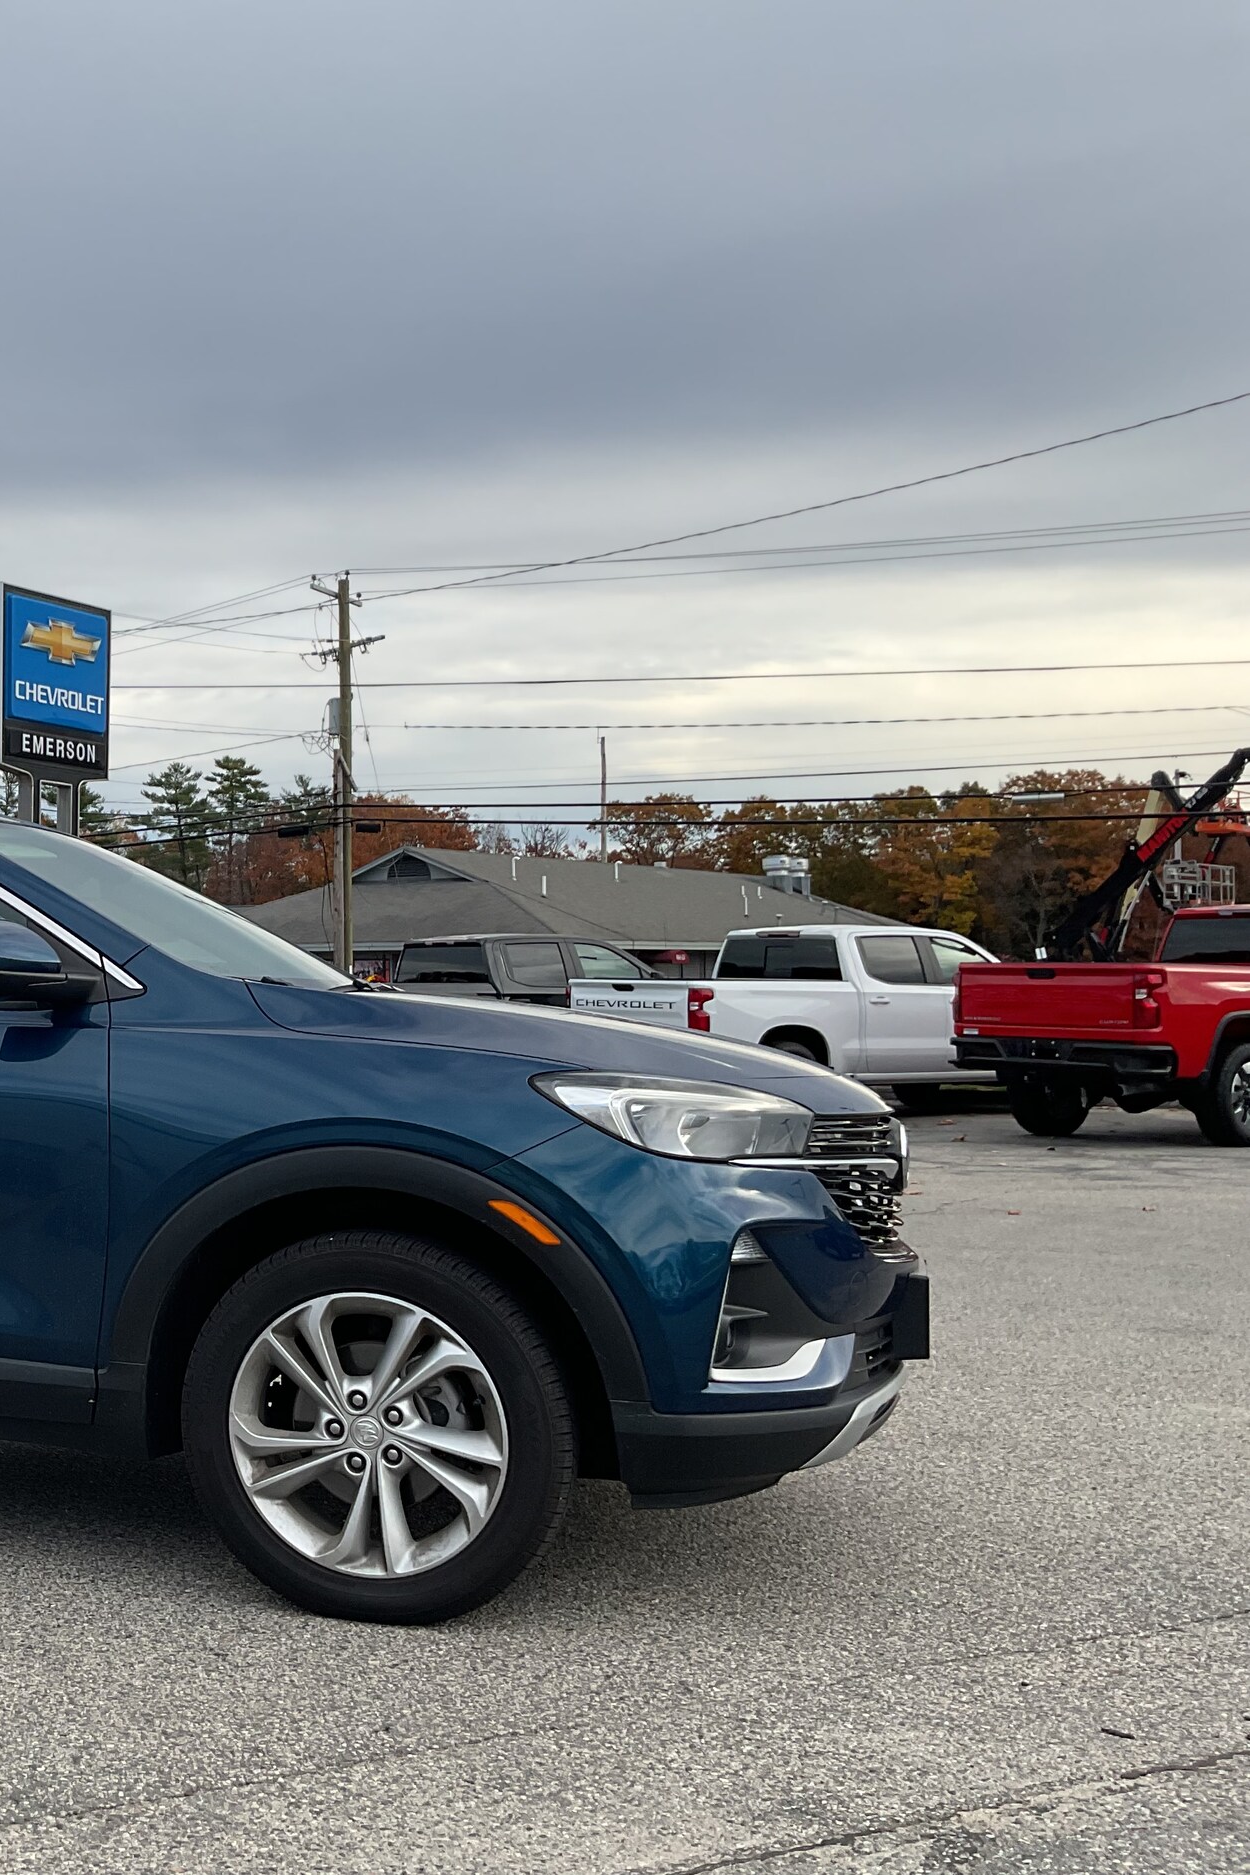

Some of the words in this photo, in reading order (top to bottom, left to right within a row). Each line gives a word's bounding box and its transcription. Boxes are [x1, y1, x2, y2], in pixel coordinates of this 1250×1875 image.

[15, 680, 104, 715] CHEVROLET
[22, 733, 96, 764] EMERSON
[576, 999, 676, 1009] CHEVROLET
